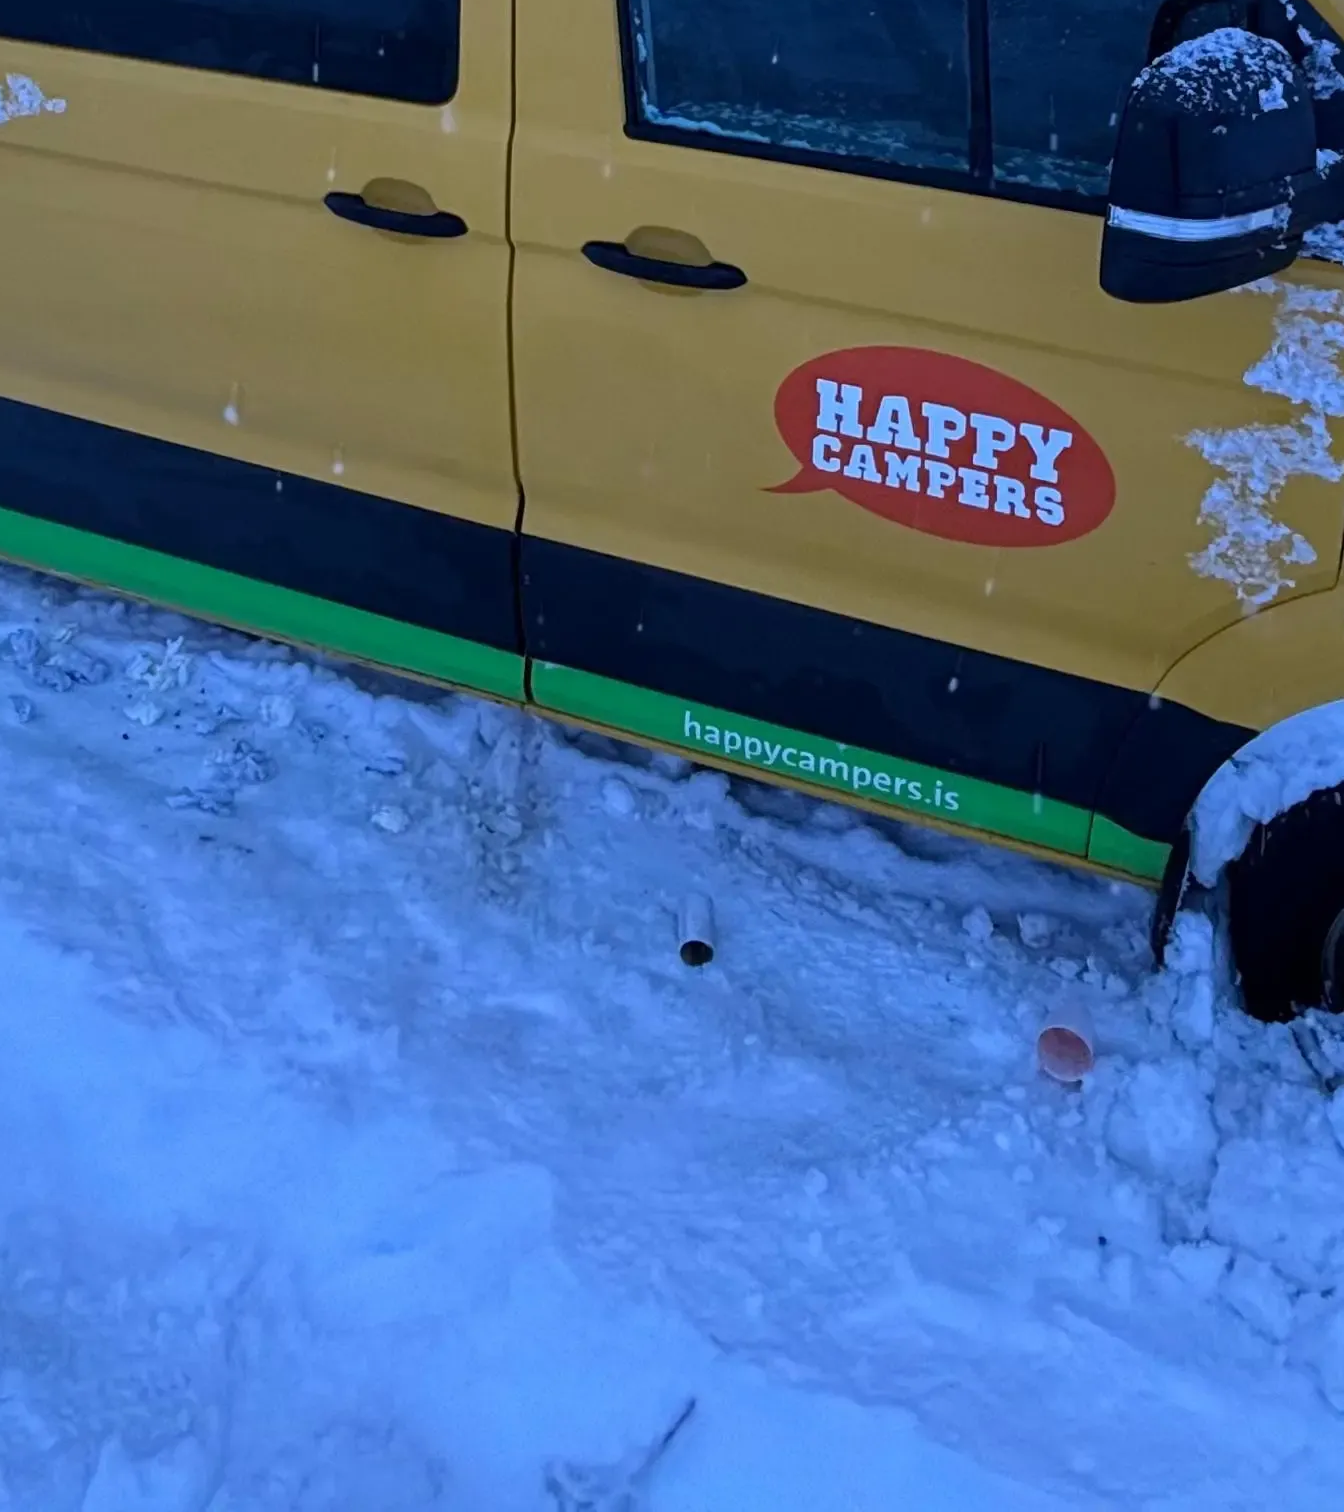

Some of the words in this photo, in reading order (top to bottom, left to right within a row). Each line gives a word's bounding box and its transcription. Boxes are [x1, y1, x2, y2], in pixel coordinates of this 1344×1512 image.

[812, 434, 1066, 527] CAMPERS
[816, 378, 1073, 483] HAPPY
[683, 710, 960, 811] happycampers.is
